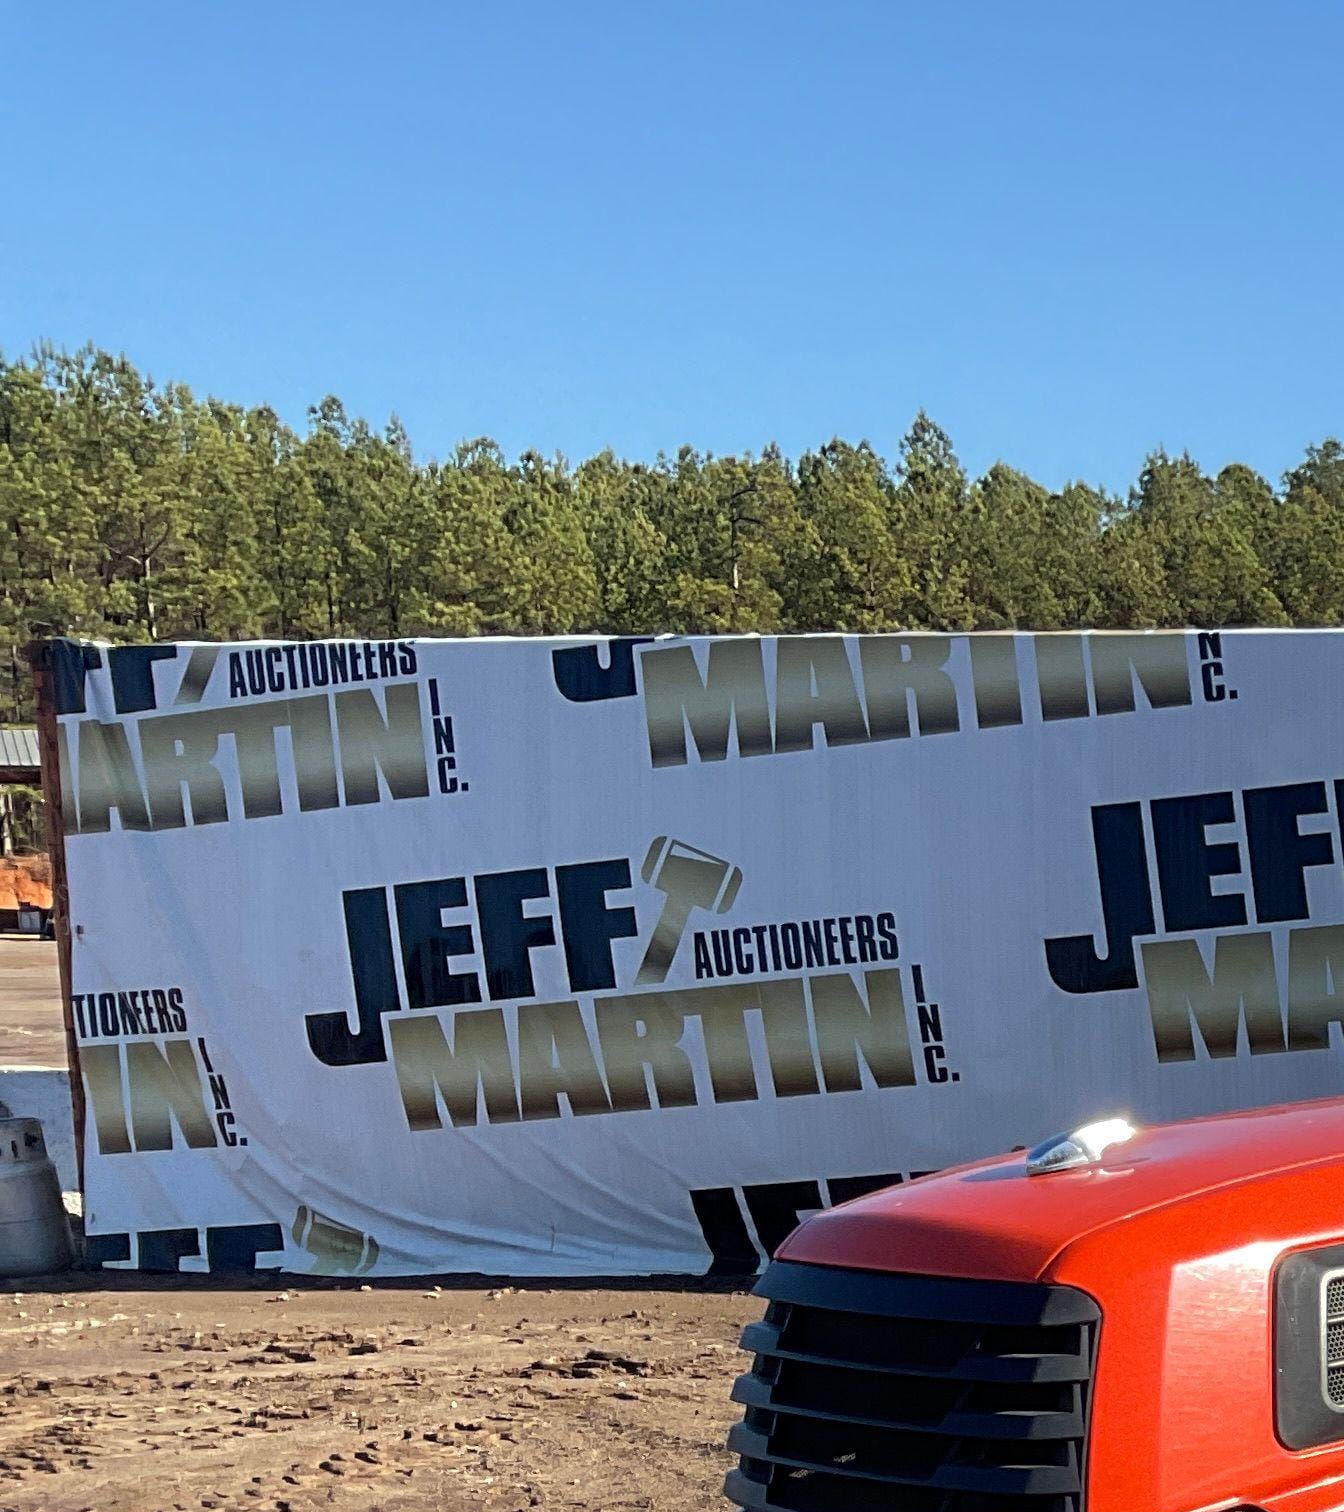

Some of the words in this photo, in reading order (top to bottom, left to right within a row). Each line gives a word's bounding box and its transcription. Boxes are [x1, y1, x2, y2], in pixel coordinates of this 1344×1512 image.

[229, 641, 417, 699] AUCTIONEERS
[57, 681, 430, 837] ARTIN
[429, 679, 469, 794] INC.
[305, 859, 638, 1066] JEFF
[694, 912, 899, 979] AUCTIONEERS
[388, 967, 917, 1132] MARTIN
[911, 965, 960, 1084] INC.
[198, 1037, 248, 1147] INC.
